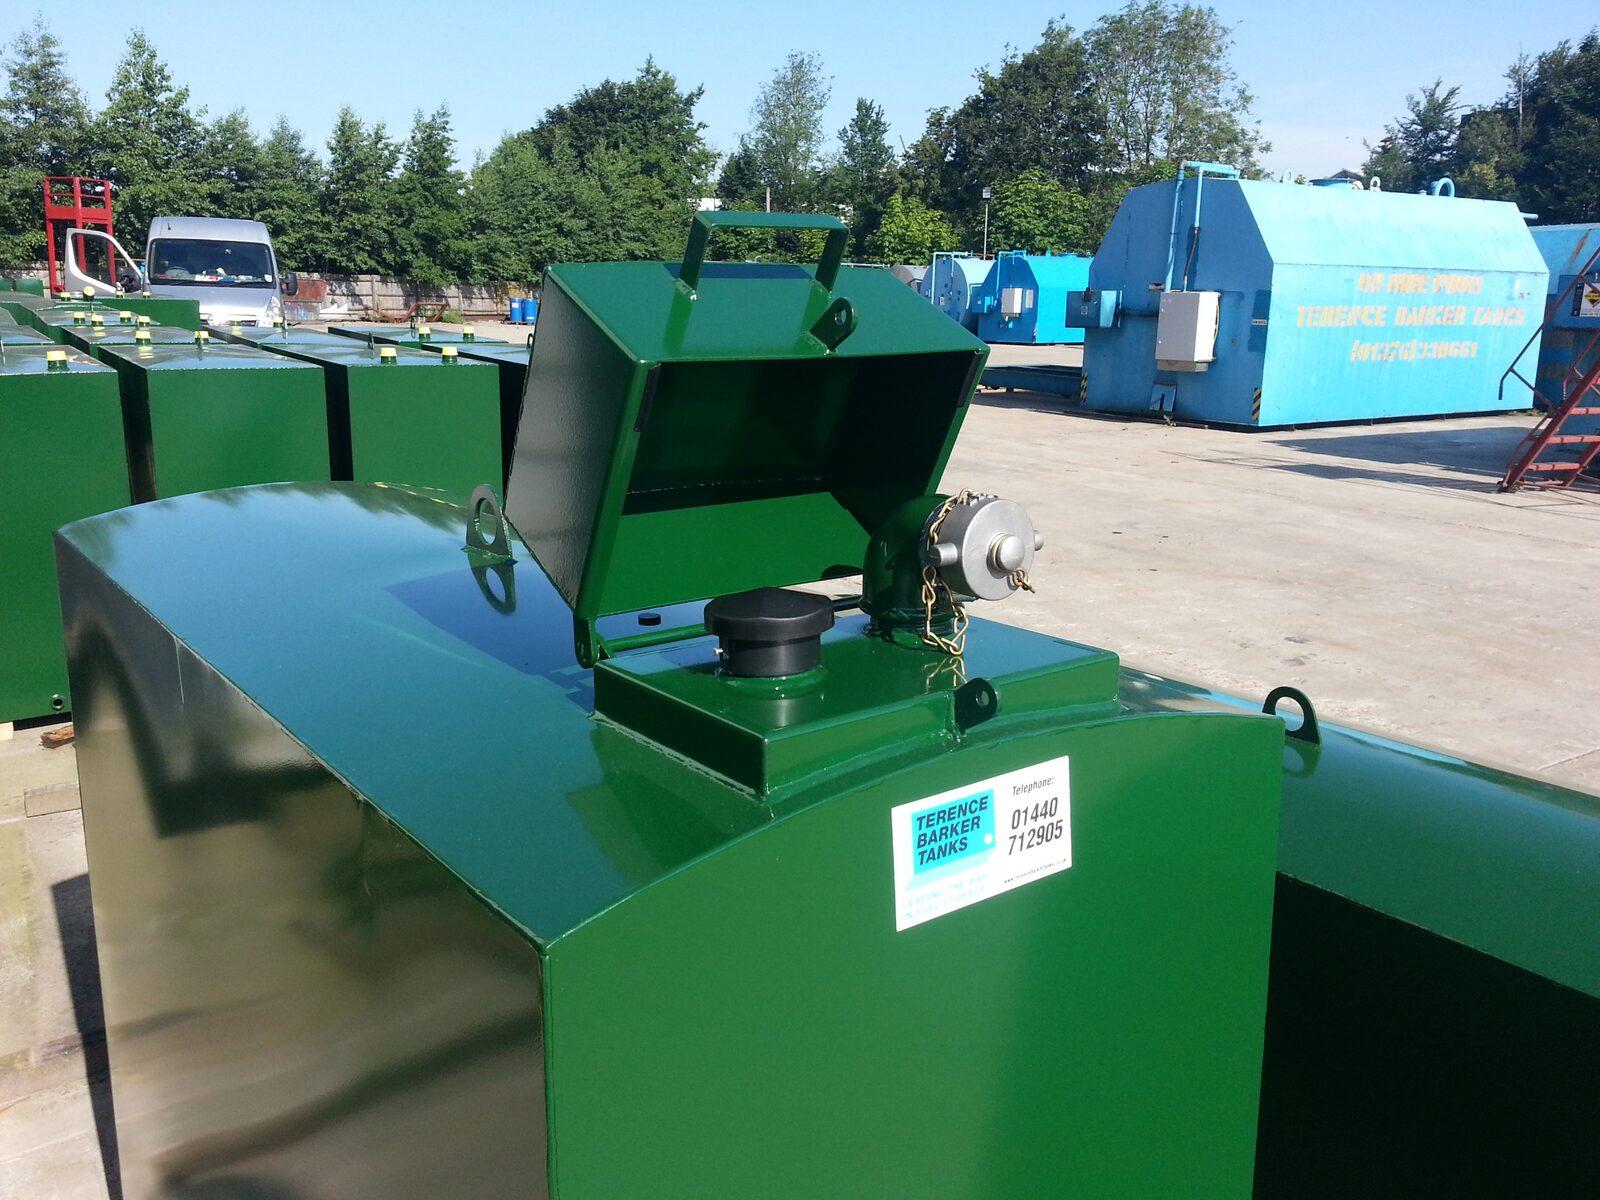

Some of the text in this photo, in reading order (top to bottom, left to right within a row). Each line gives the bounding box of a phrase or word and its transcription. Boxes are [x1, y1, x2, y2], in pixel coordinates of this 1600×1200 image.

[1296, 305, 1525, 327] TERENCE BARKER TANKS
[1013, 776, 1056, 796] Telephone:
[917, 795, 989, 831] TERENCE
[1011, 797, 1058, 830] 01440
[917, 815, 981, 849] BARKER
[1008, 819, 1063, 855] 712905
[918, 836, 968, 866] TANKS
